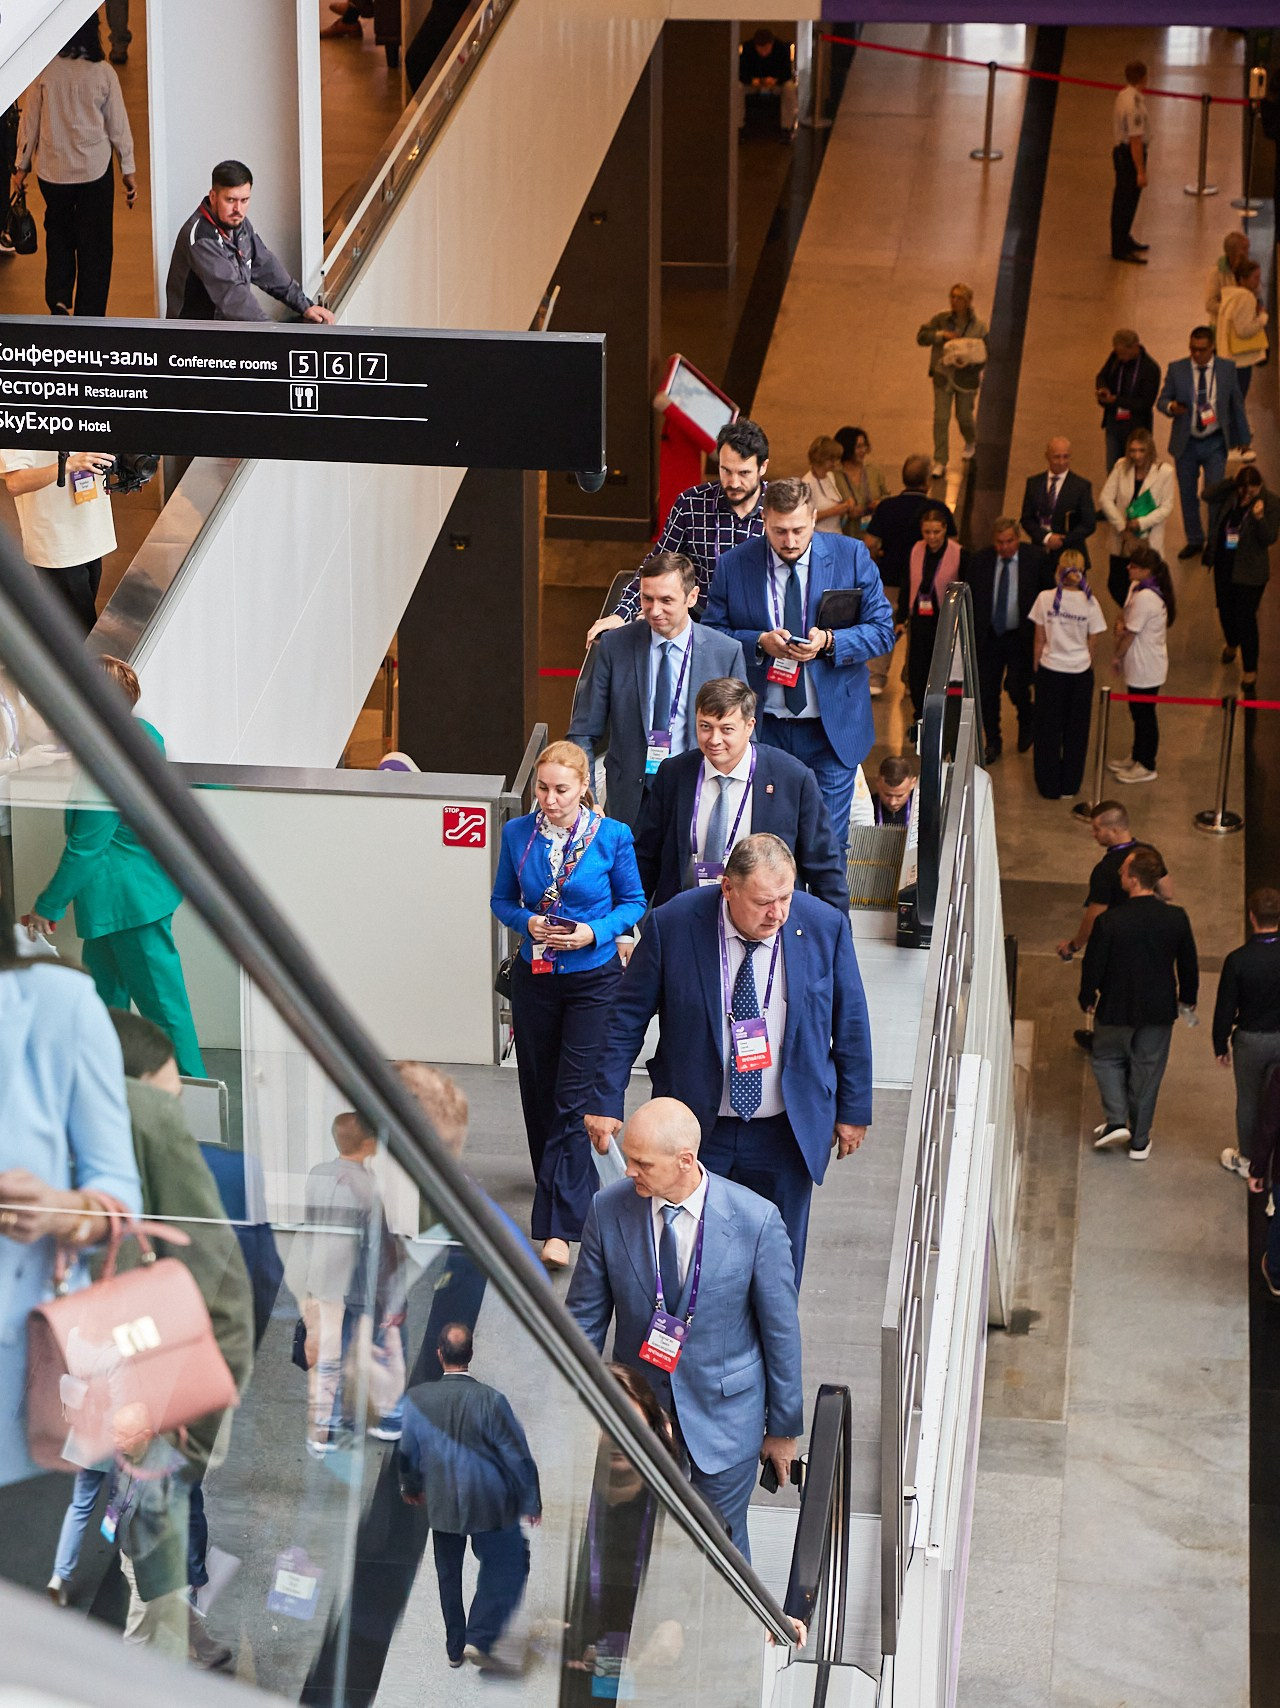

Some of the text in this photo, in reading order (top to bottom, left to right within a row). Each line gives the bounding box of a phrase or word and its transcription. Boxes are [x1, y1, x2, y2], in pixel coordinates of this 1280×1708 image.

[168, 354, 237, 369] Conference
[239, 358, 278, 371] rooms
[297, 355, 310, 374] 5
[331, 356, 345, 375] 6
[366, 357, 379, 376] 7
[84, 386, 149, 400] Restaurant
[78, 419, 112, 433] Hotel
